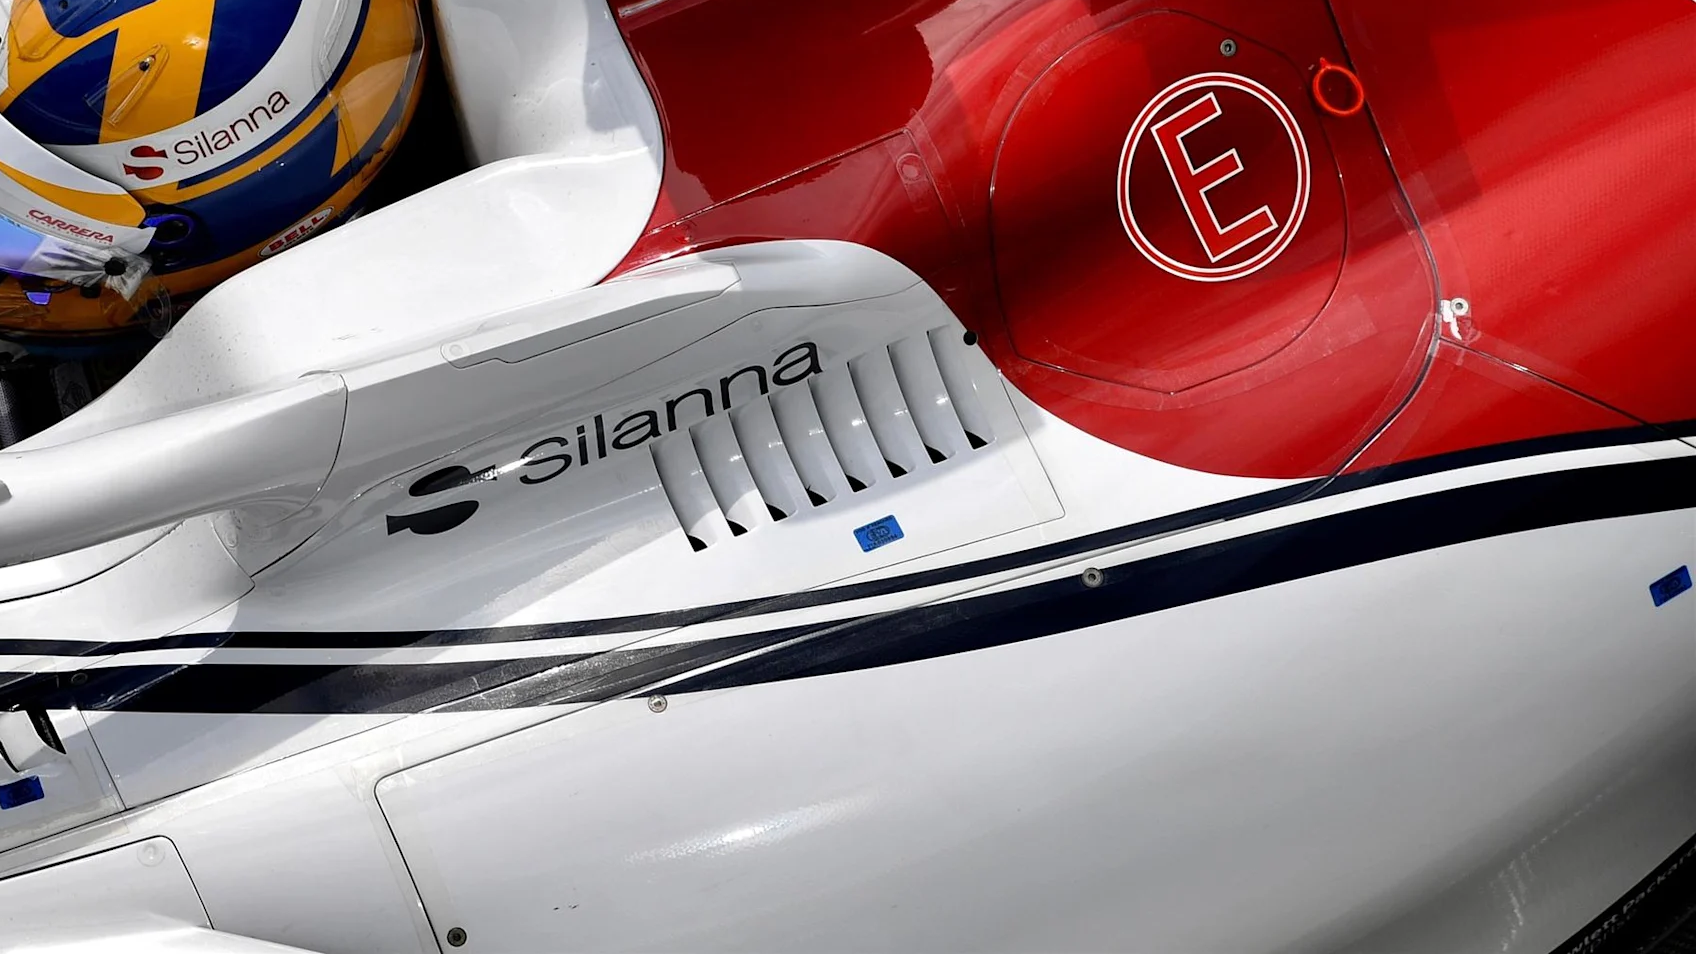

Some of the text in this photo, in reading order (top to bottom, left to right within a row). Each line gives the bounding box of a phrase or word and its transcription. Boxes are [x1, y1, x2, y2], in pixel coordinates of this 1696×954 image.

[174, 90, 291, 165] Silanna
[1150, 91, 1278, 264] E
[28, 208, 115, 244] CARRERA
[269, 217, 325, 252] BELL
[517, 339, 824, 486] Silanna
